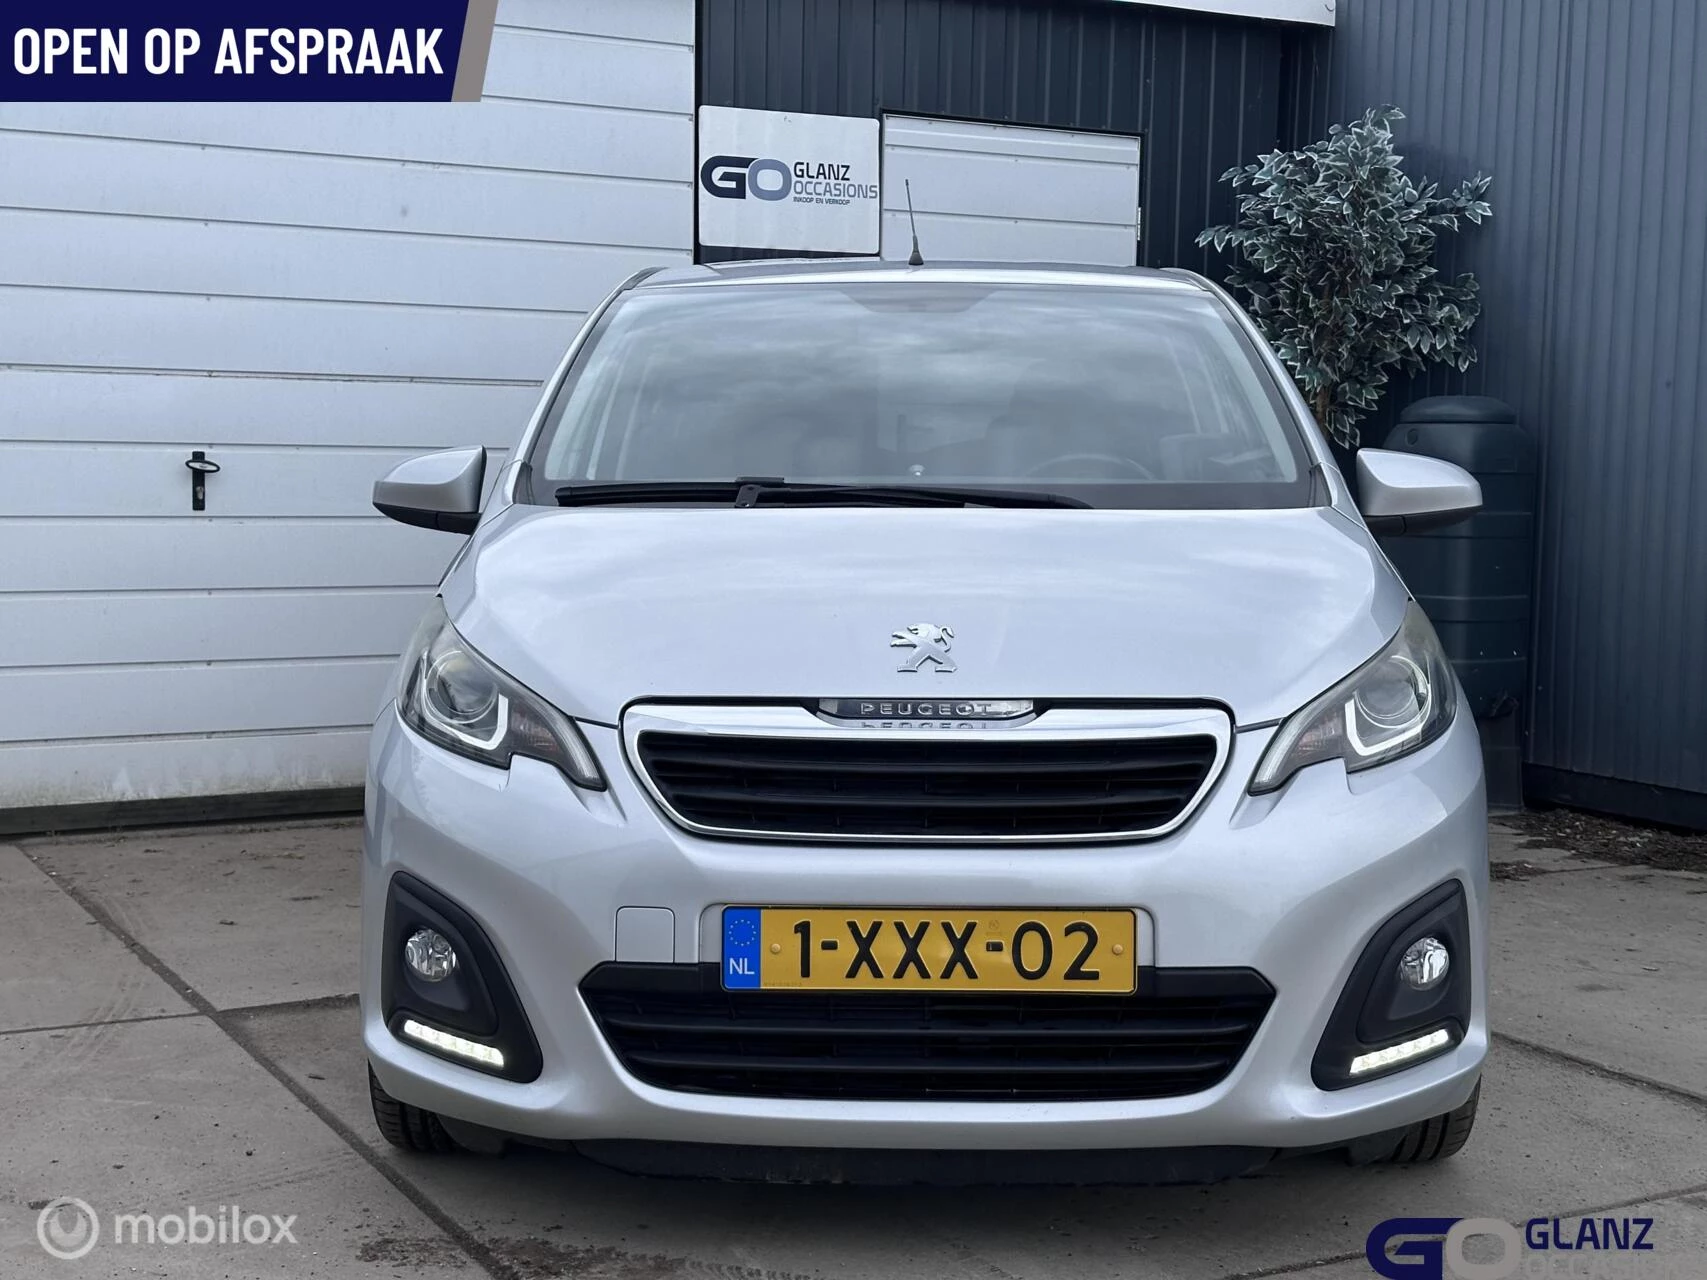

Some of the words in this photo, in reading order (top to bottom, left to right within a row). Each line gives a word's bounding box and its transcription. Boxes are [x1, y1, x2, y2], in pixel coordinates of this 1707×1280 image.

[701, 155, 792, 200] GO
[794, 161, 850, 181] GLANZ
[794, 181, 878, 199] OCCASIONS
[815, 197, 824, 205] EN
[860, 702, 992, 715] PEUGEOT
[793, 920, 1100, 980] 1-XXX-02
[729, 957, 755, 975] NL
